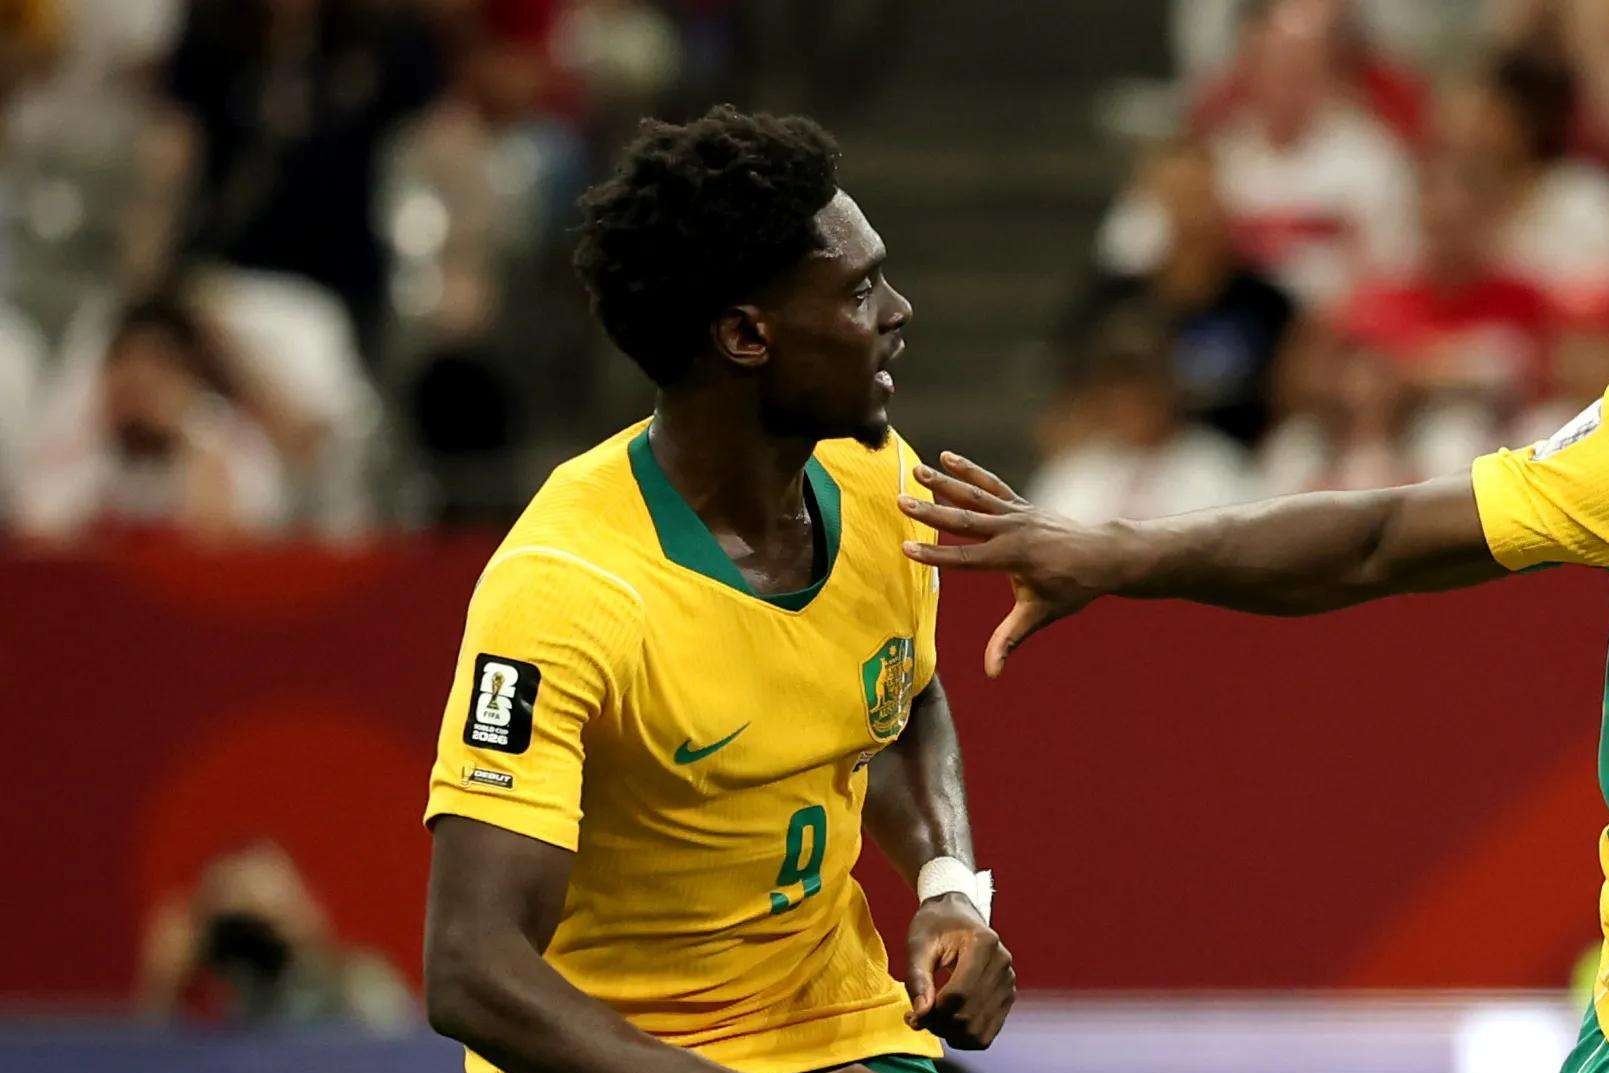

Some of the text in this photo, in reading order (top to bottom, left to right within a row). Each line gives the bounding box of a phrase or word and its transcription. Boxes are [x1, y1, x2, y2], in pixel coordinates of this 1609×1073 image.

[472, 730, 508, 745] 2026
[474, 769, 512, 782] DEBUT
[769, 804, 827, 916] 9
